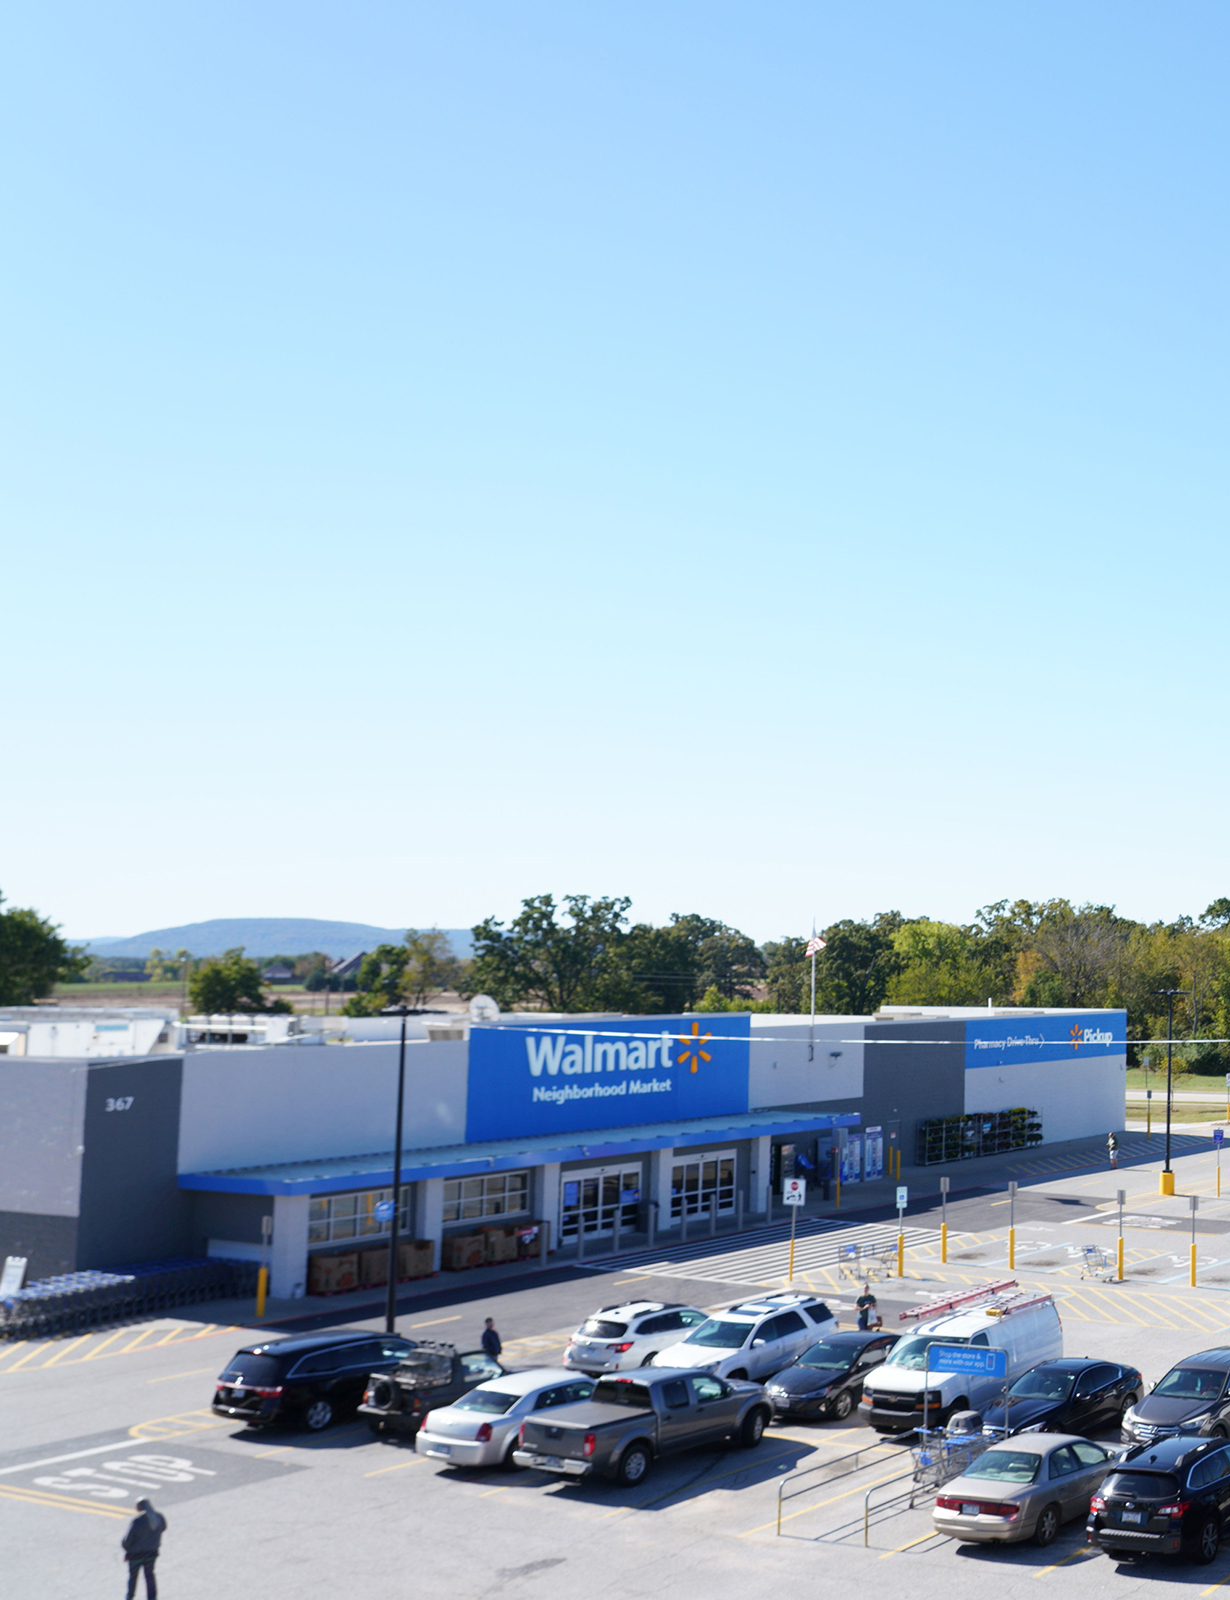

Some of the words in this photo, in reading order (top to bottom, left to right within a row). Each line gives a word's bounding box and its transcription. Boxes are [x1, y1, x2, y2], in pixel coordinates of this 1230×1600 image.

[974, 1038, 1006, 1050] Pharmacy
[1083, 1028, 1113, 1047] Pickup
[525, 1030, 674, 1077] Walmart
[533, 1081, 627, 1105] Neighborhood
[628, 1078, 673, 1095] Market
[105, 1096, 135, 1112] 367
[31, 1453, 218, 1498] STOP
